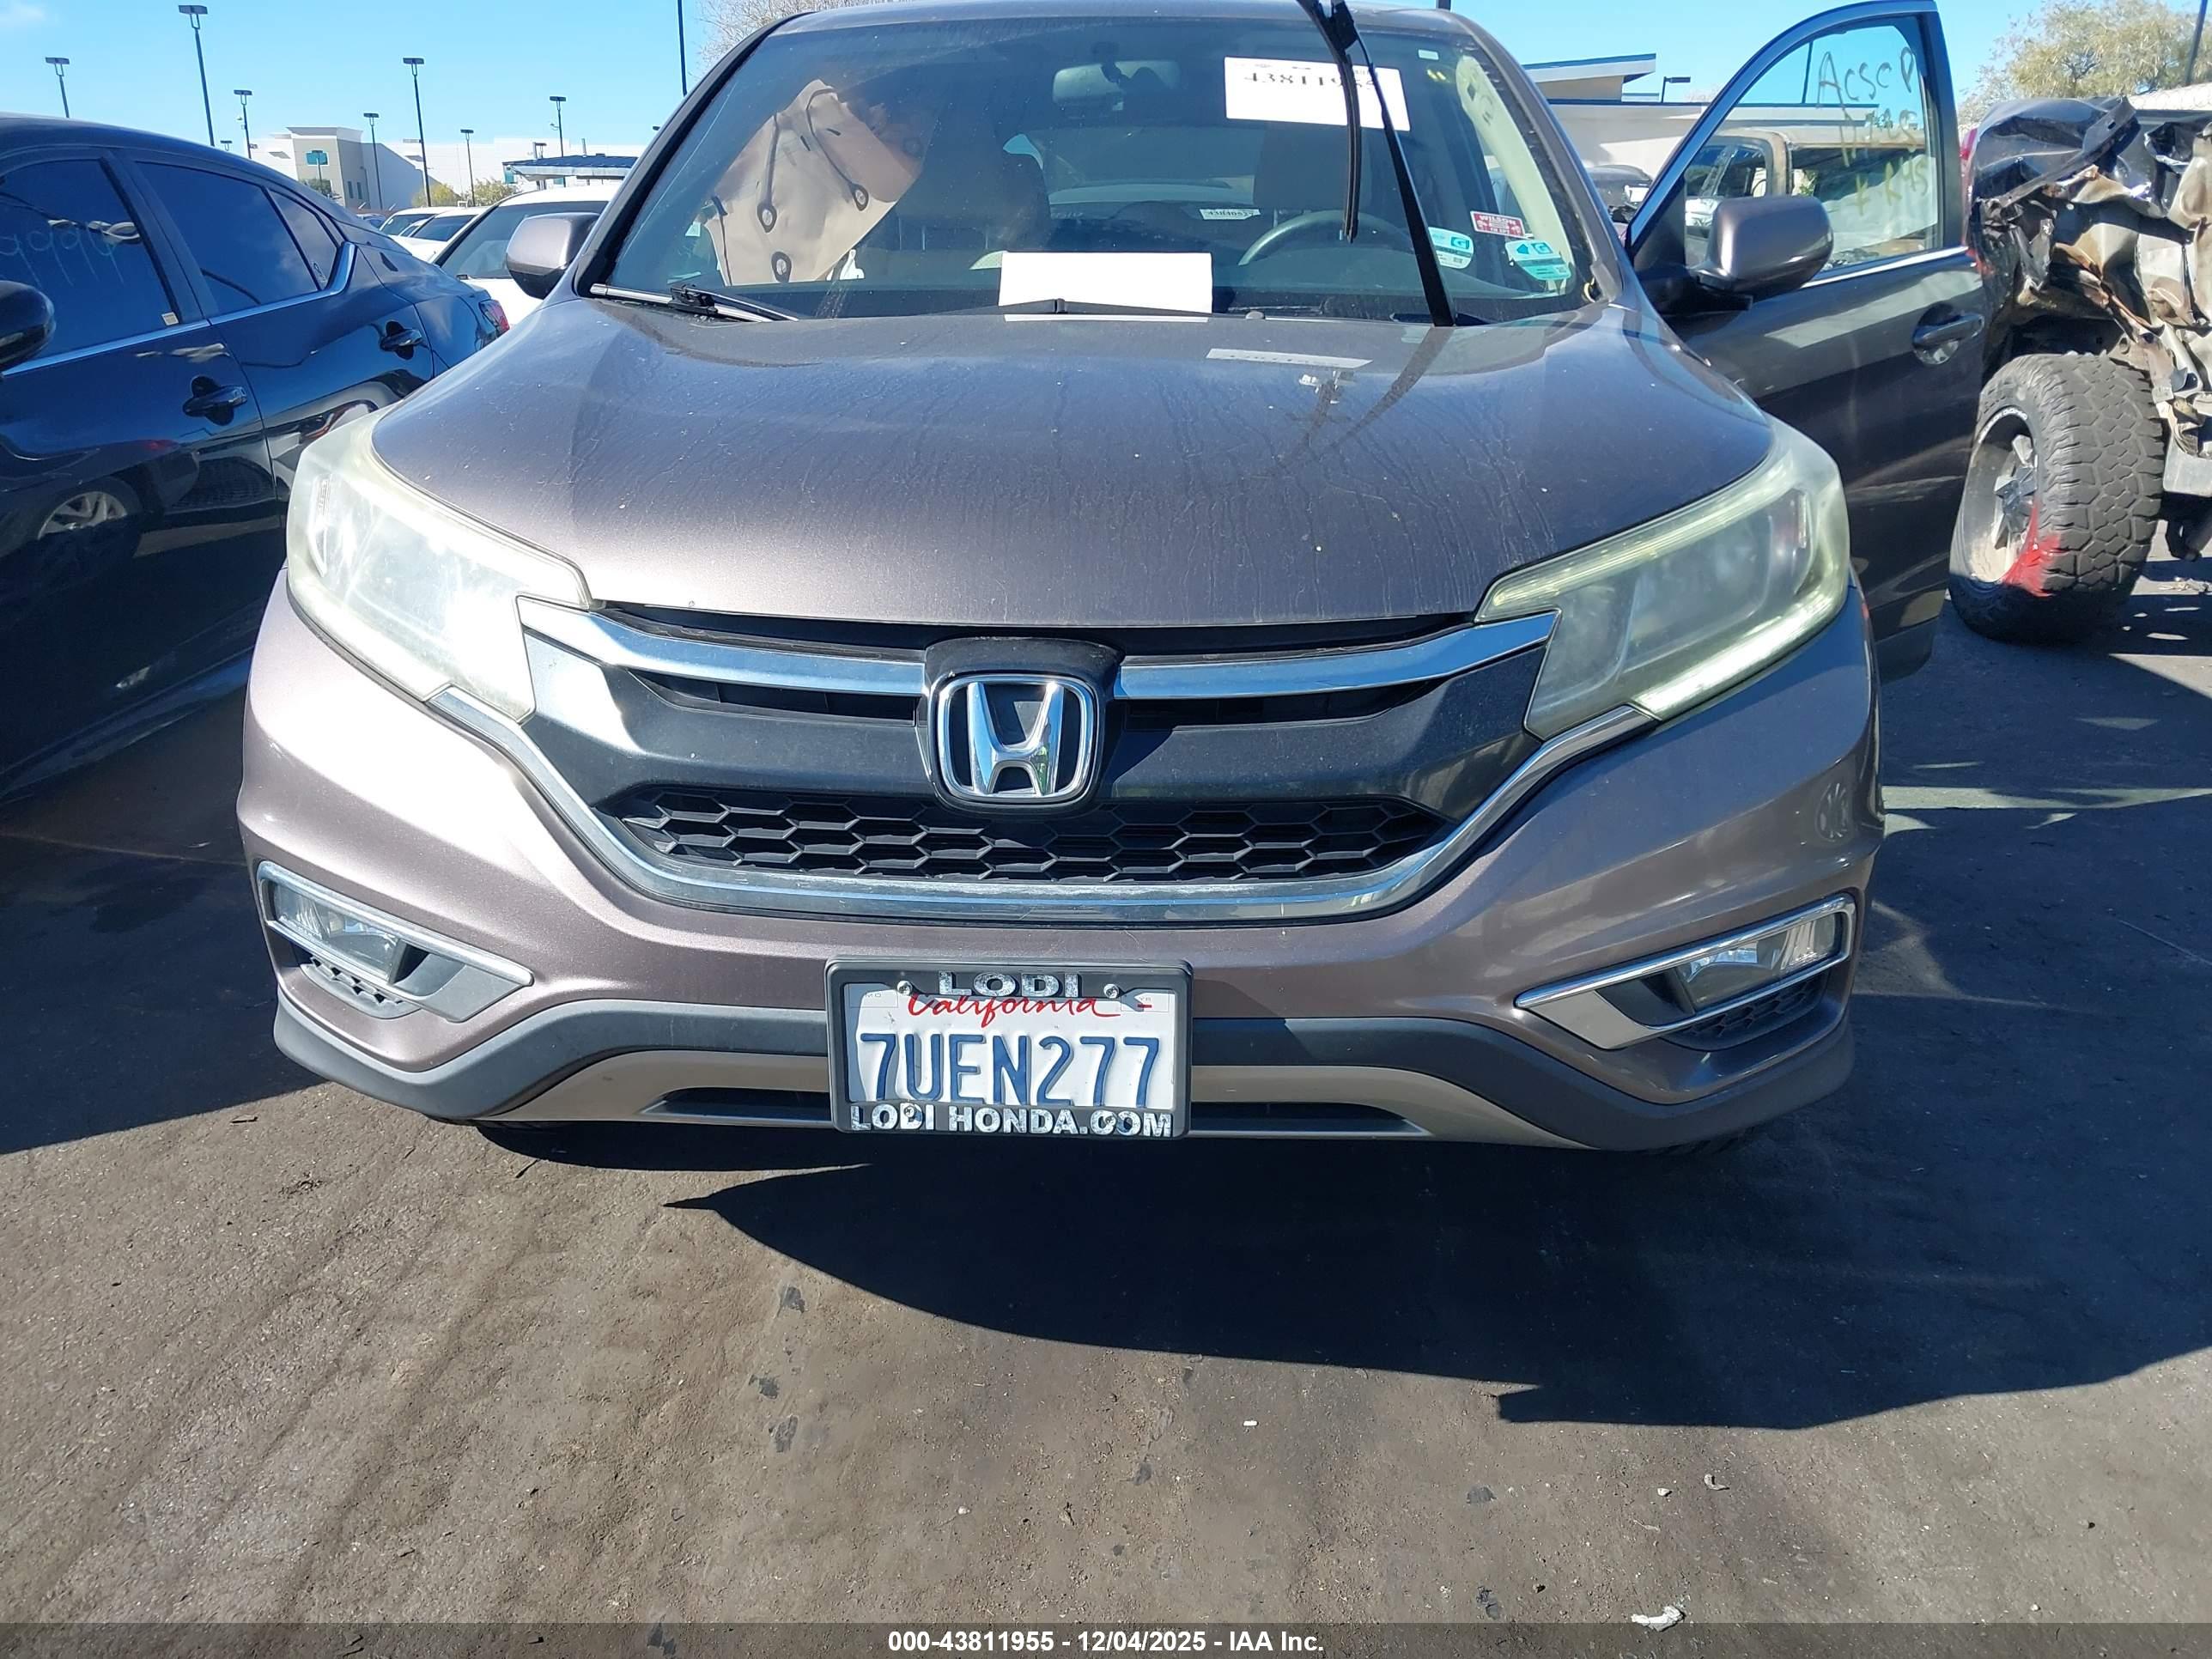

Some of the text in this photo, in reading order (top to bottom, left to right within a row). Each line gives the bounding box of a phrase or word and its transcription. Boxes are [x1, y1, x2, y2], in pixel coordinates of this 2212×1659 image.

[939, 970, 1079, 998] LODI
[908, 994, 1121, 1028] California
[860, 1033, 1159, 1108] 7UEN277
[850, 1103, 1173, 1137] LODI HONDA.COM
